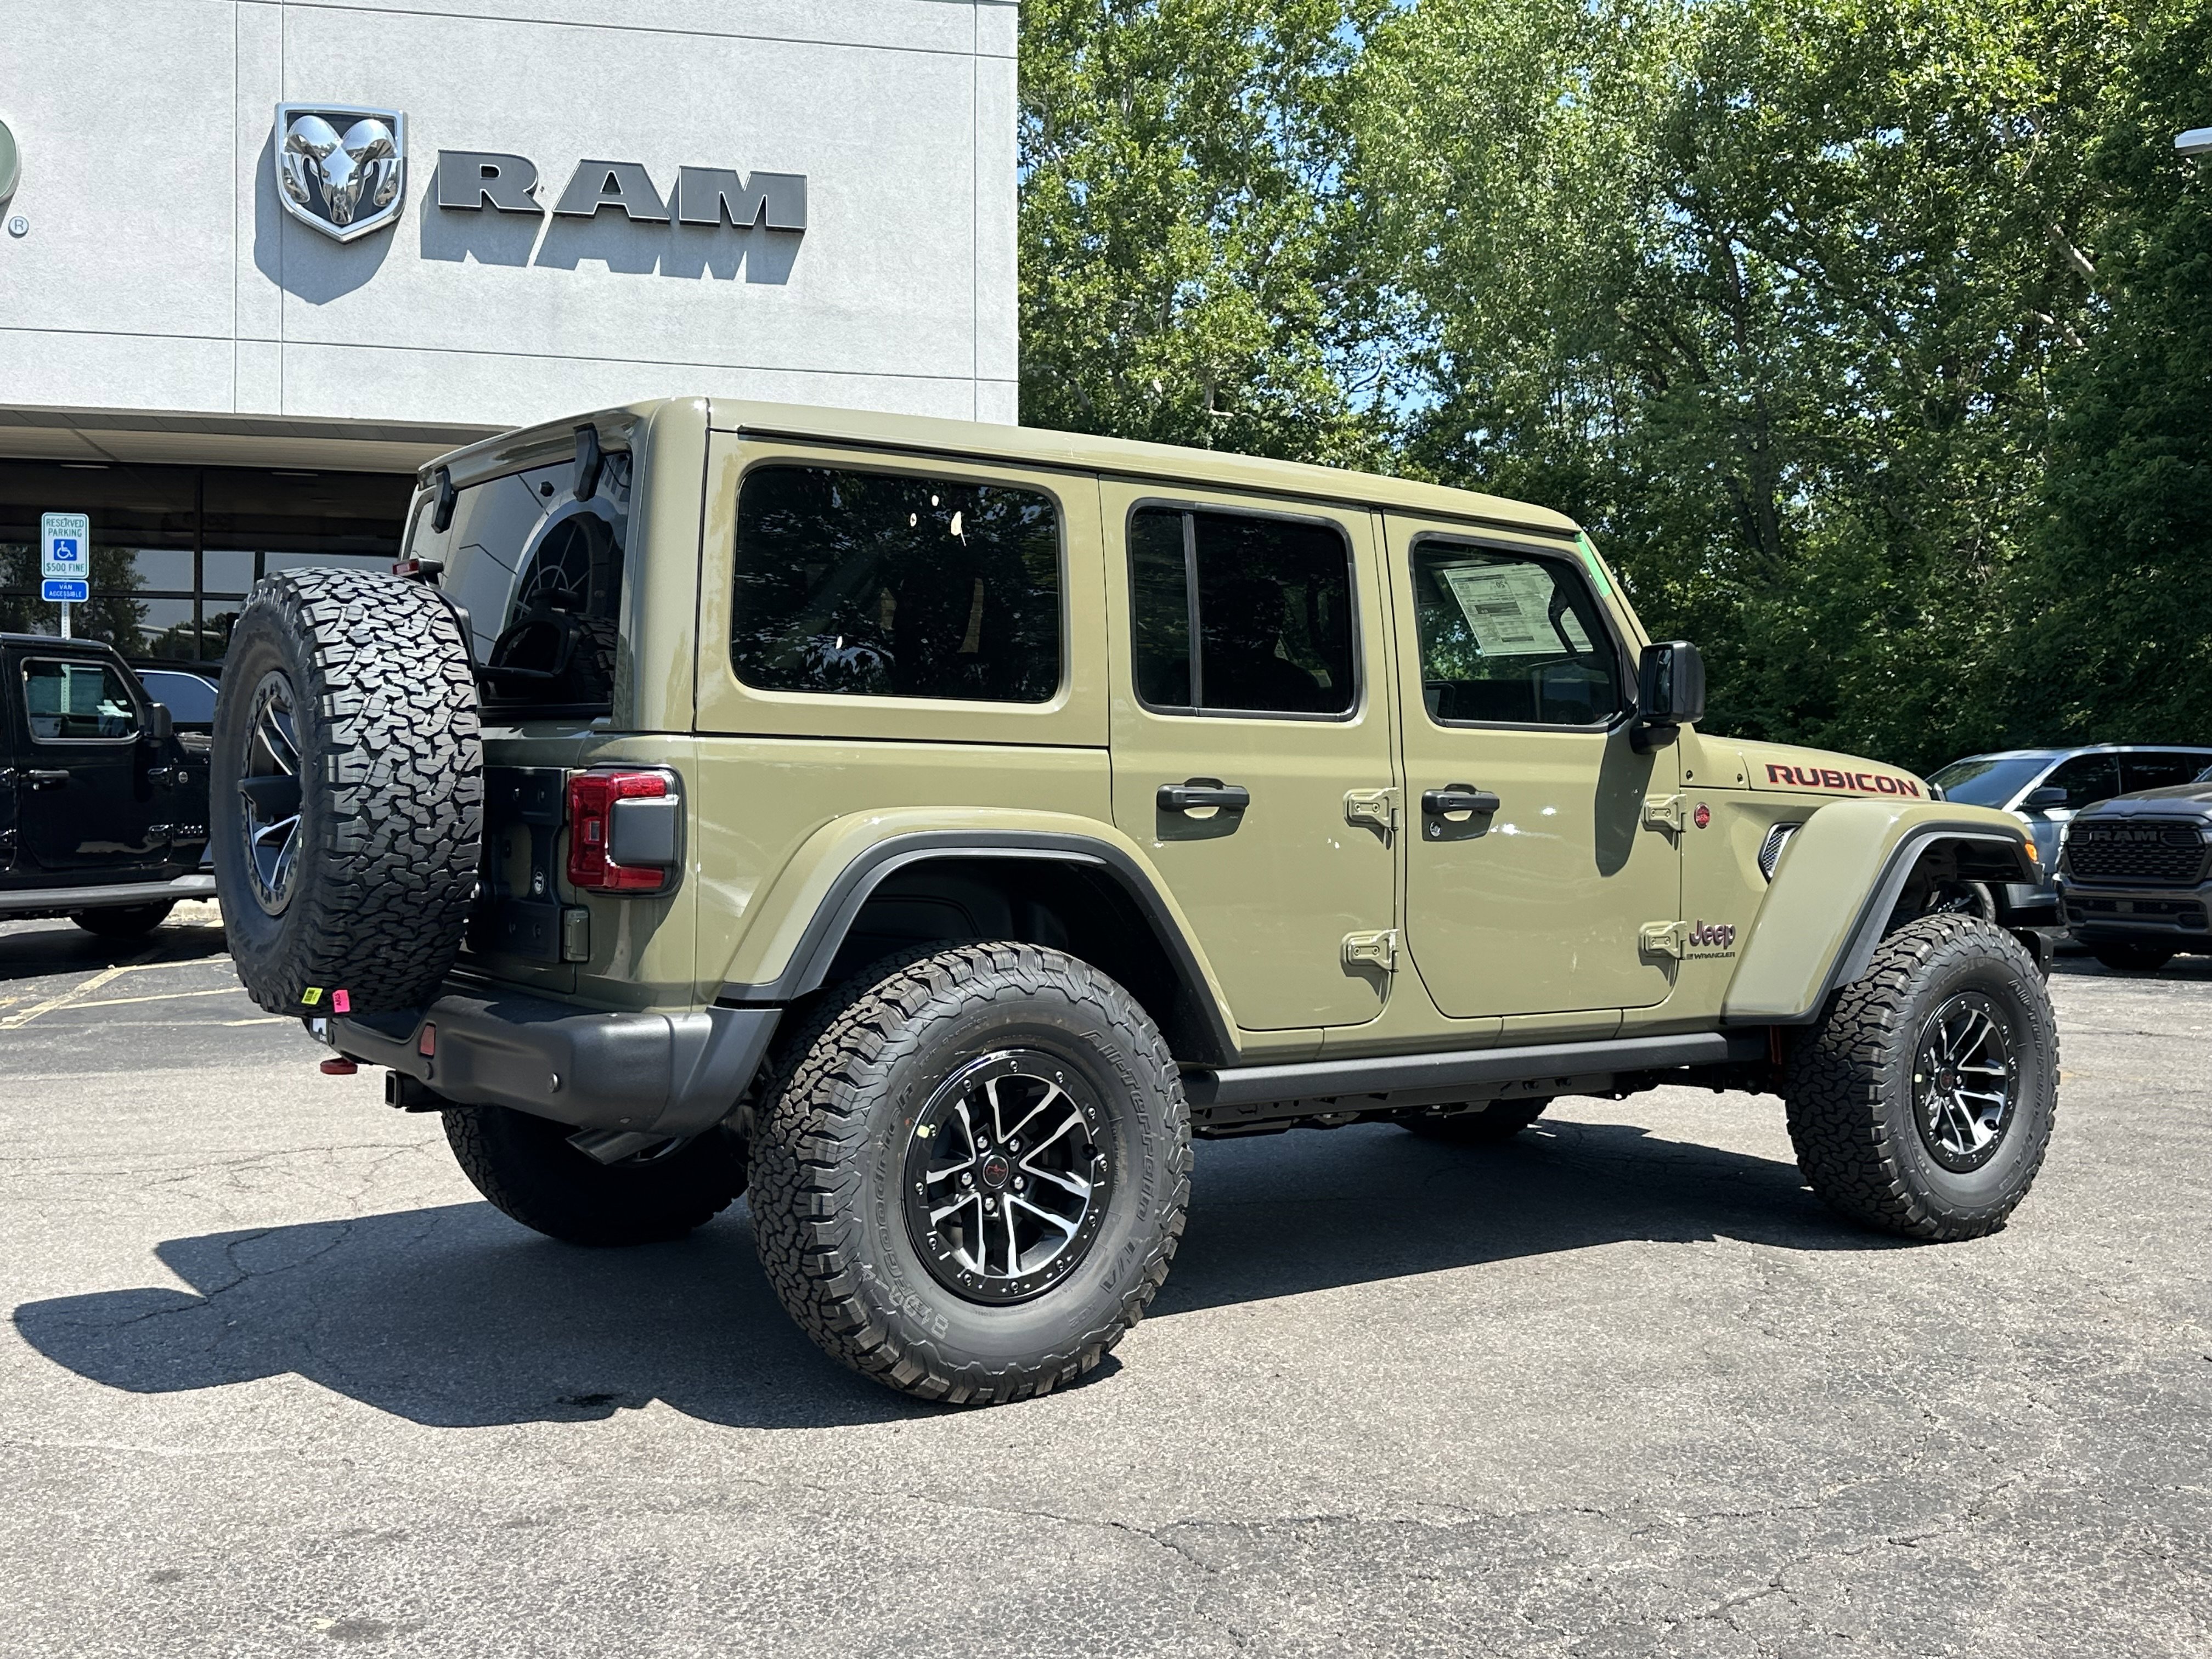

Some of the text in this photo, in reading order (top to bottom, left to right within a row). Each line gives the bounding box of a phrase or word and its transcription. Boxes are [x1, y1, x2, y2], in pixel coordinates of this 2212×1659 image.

[438, 150, 807, 232] RAM
[46, 518, 84, 528] RESERVED
[48, 528, 82, 537] PARKING
[46, 562, 84, 572] $500 FINE
[1765, 764, 1921, 798] RUBICON
[2094, 831, 2157, 841] RAM
[1689, 918, 1736, 950] Jeep
[1694, 951, 1736, 960] WRANGLER
